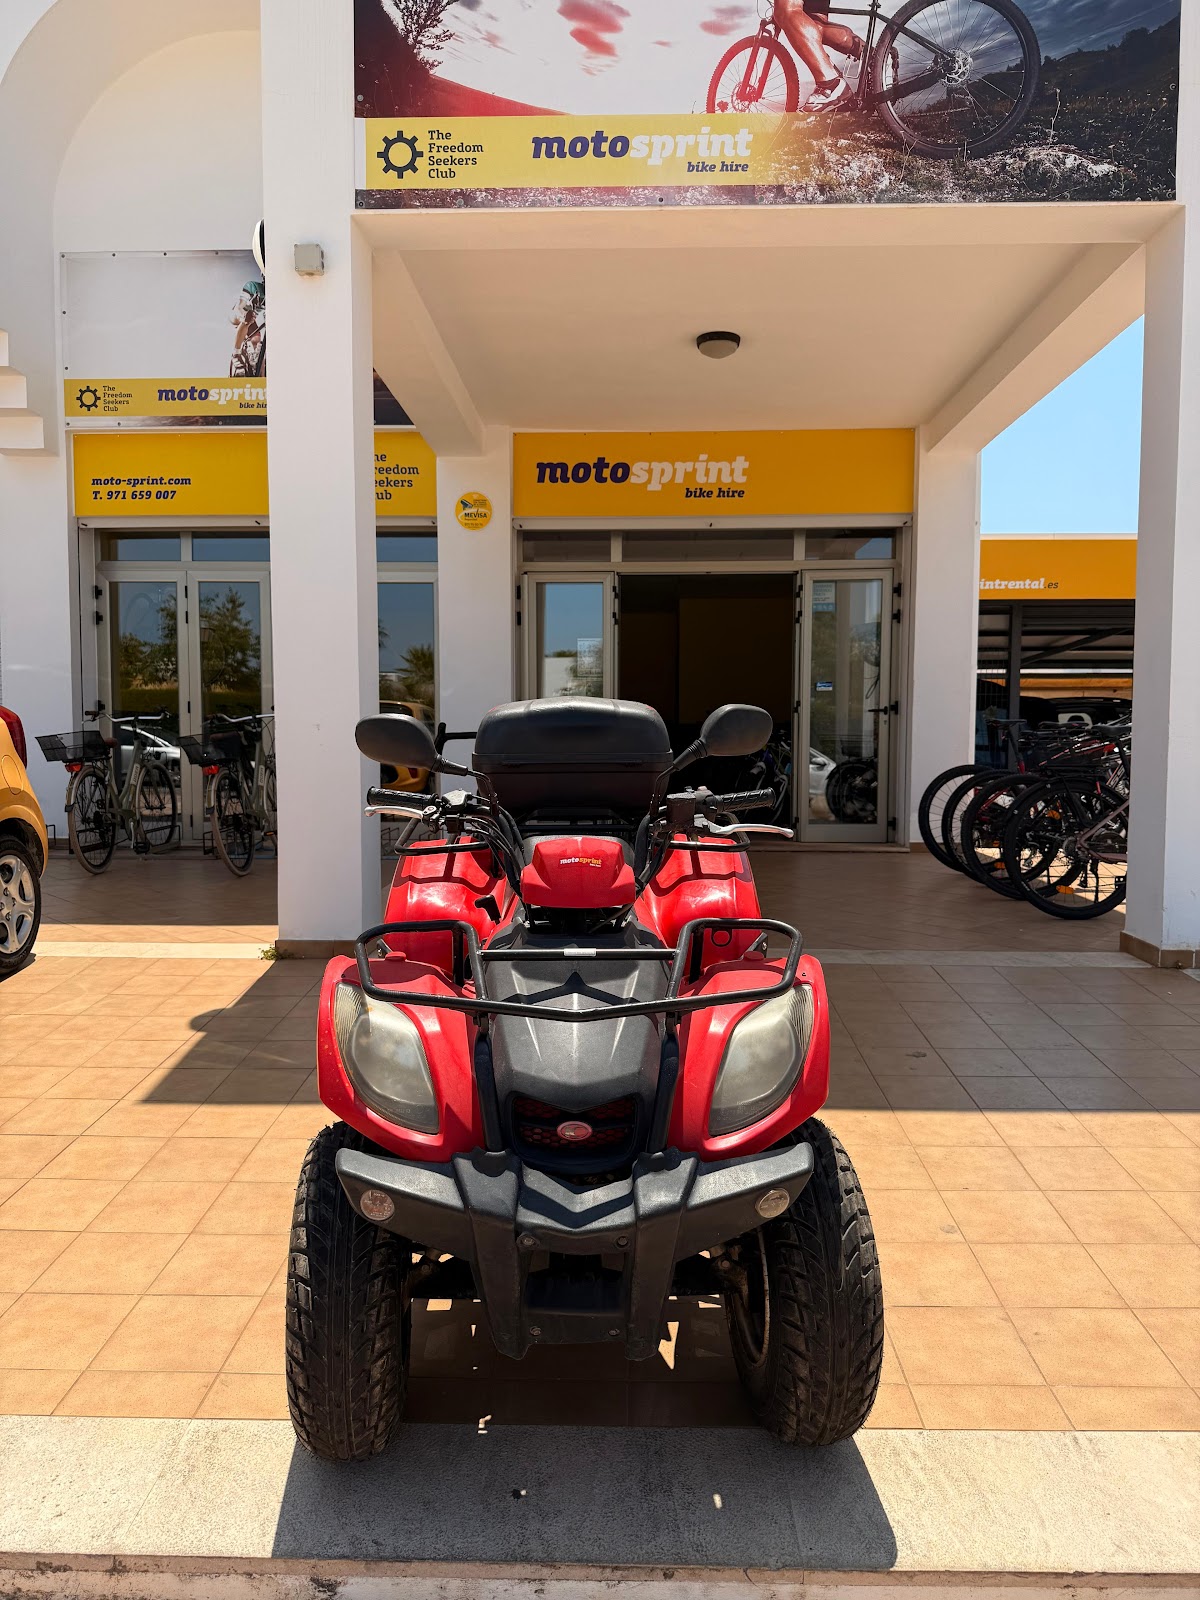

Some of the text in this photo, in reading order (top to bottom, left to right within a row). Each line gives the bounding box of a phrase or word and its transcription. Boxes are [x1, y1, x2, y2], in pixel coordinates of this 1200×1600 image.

[428, 130, 452, 140] The
[428, 142, 484, 153] Freedom
[531, 126, 753, 166] motosprint
[428, 155, 478, 166] Seekers
[687, 161, 749, 173] bike hire
[428, 168, 456, 179] Club
[157, 383, 267, 405] motosprin
[536, 454, 749, 491] motosprint
[91, 475, 192, 488] moto-sprint.com
[92, 490, 177, 500] T. 971 659 007
[685, 488, 745, 499] bike hire
[464, 510, 488, 519] MEVISA
